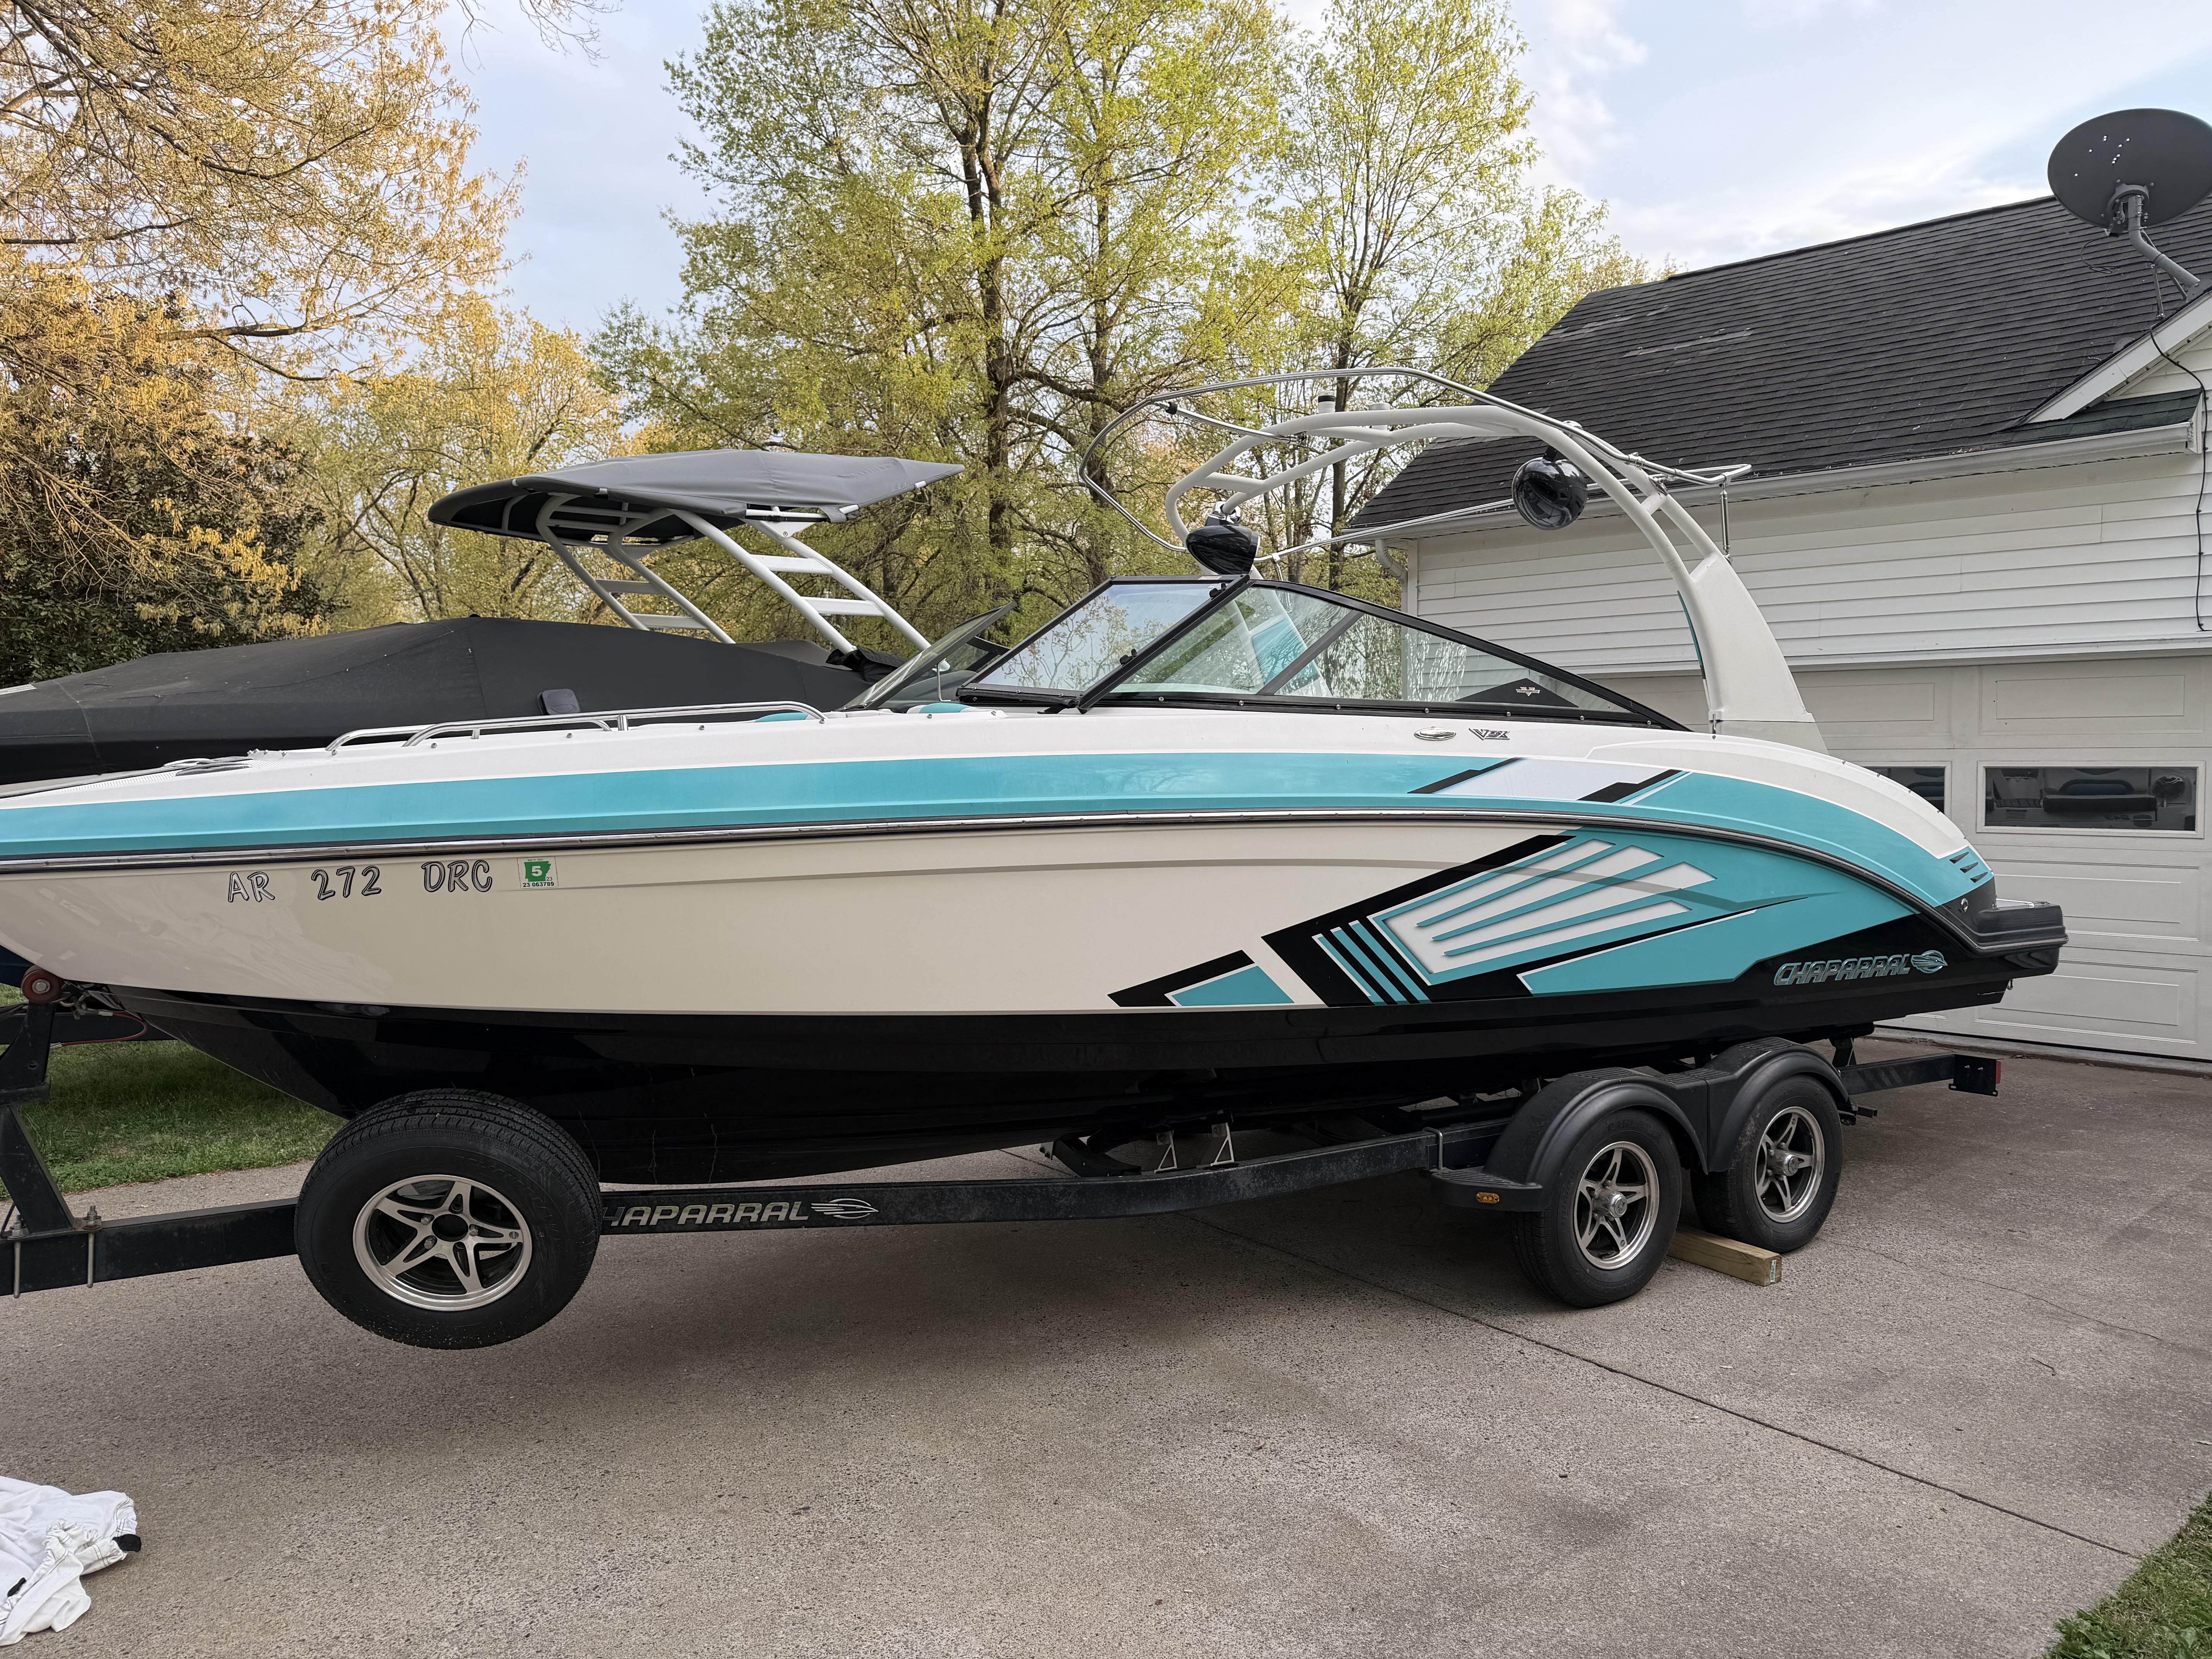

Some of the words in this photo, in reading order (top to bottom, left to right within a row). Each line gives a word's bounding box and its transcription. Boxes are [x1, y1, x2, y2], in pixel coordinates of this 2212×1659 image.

[228, 871, 275, 903] AR
[311, 865, 382, 900] 272
[421, 860, 493, 892] DRC
[531, 866, 543, 877] 5
[1774, 953, 1910, 986] CHAPARRAL
[602, 1201, 809, 1227] HAPARRAL
